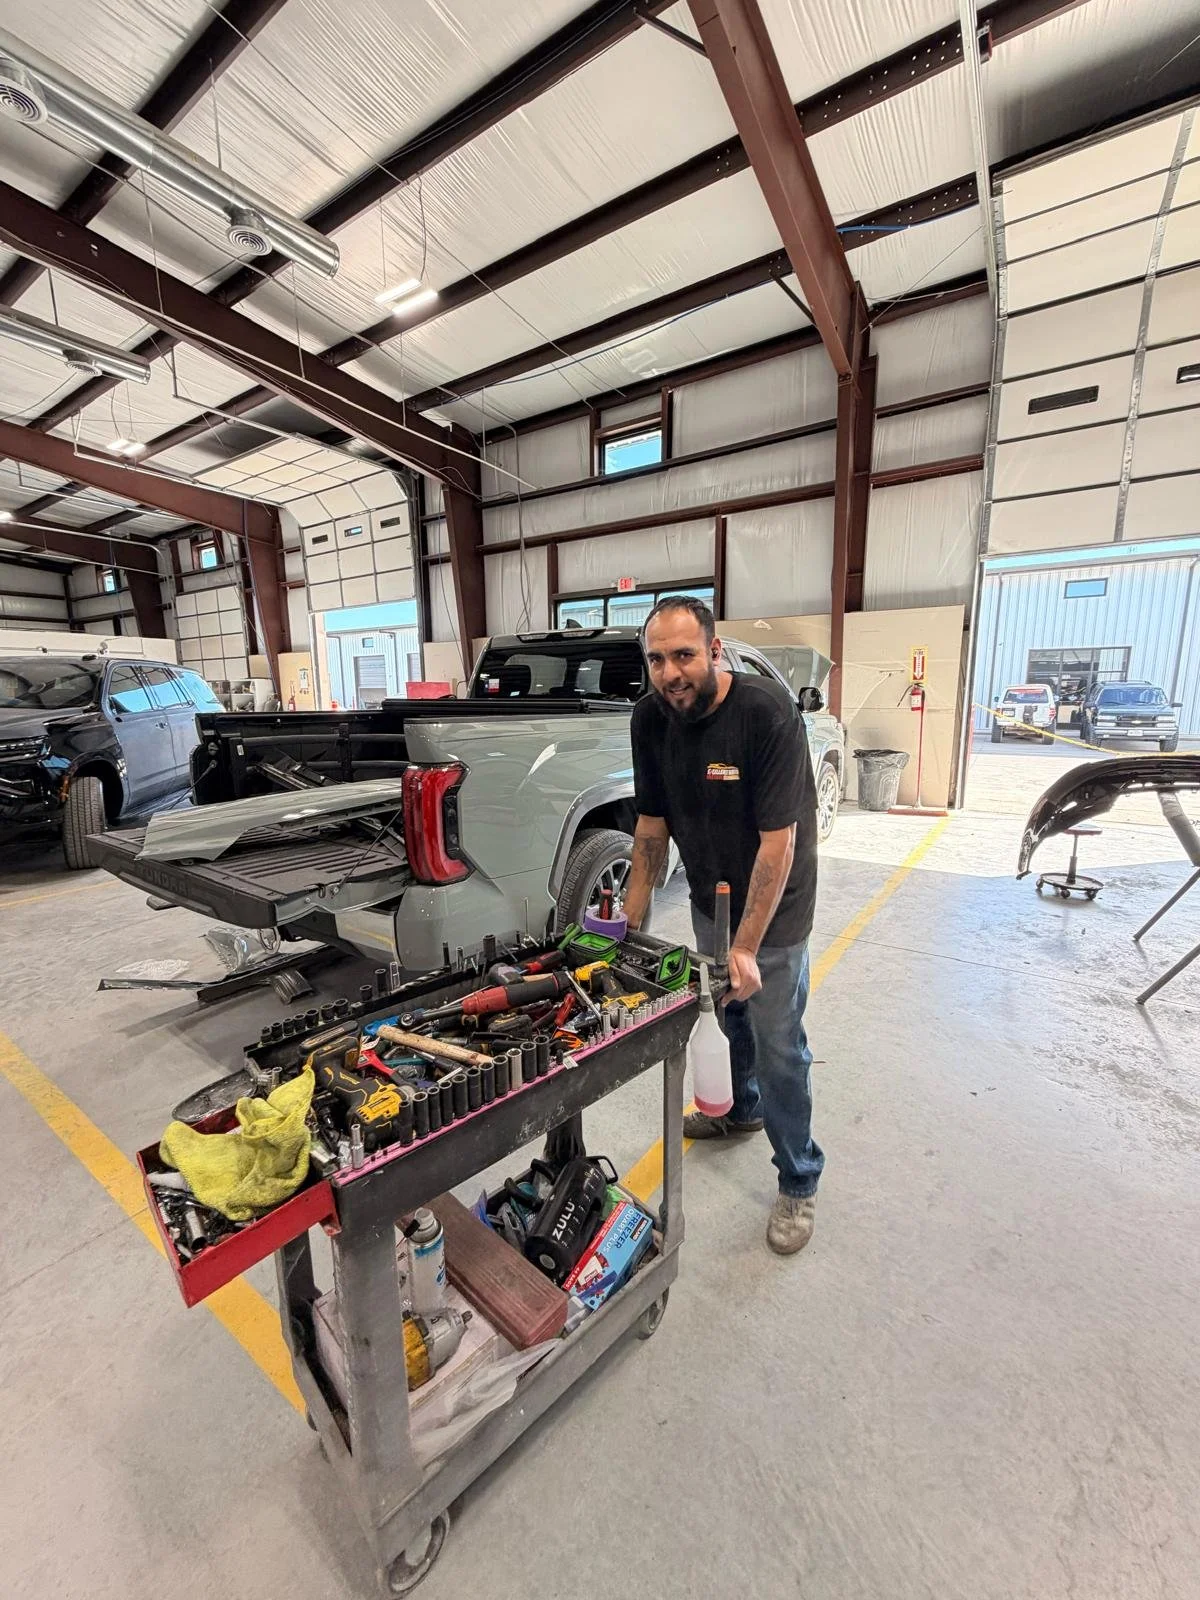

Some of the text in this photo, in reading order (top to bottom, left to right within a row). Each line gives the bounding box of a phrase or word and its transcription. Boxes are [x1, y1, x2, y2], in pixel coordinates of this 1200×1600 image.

[552, 1201, 576, 1241] ZULU
[615, 1213, 641, 1249] FREEZER
[617, 1208, 635, 1233] QUART
[603, 1233, 619, 1253] PLUS
